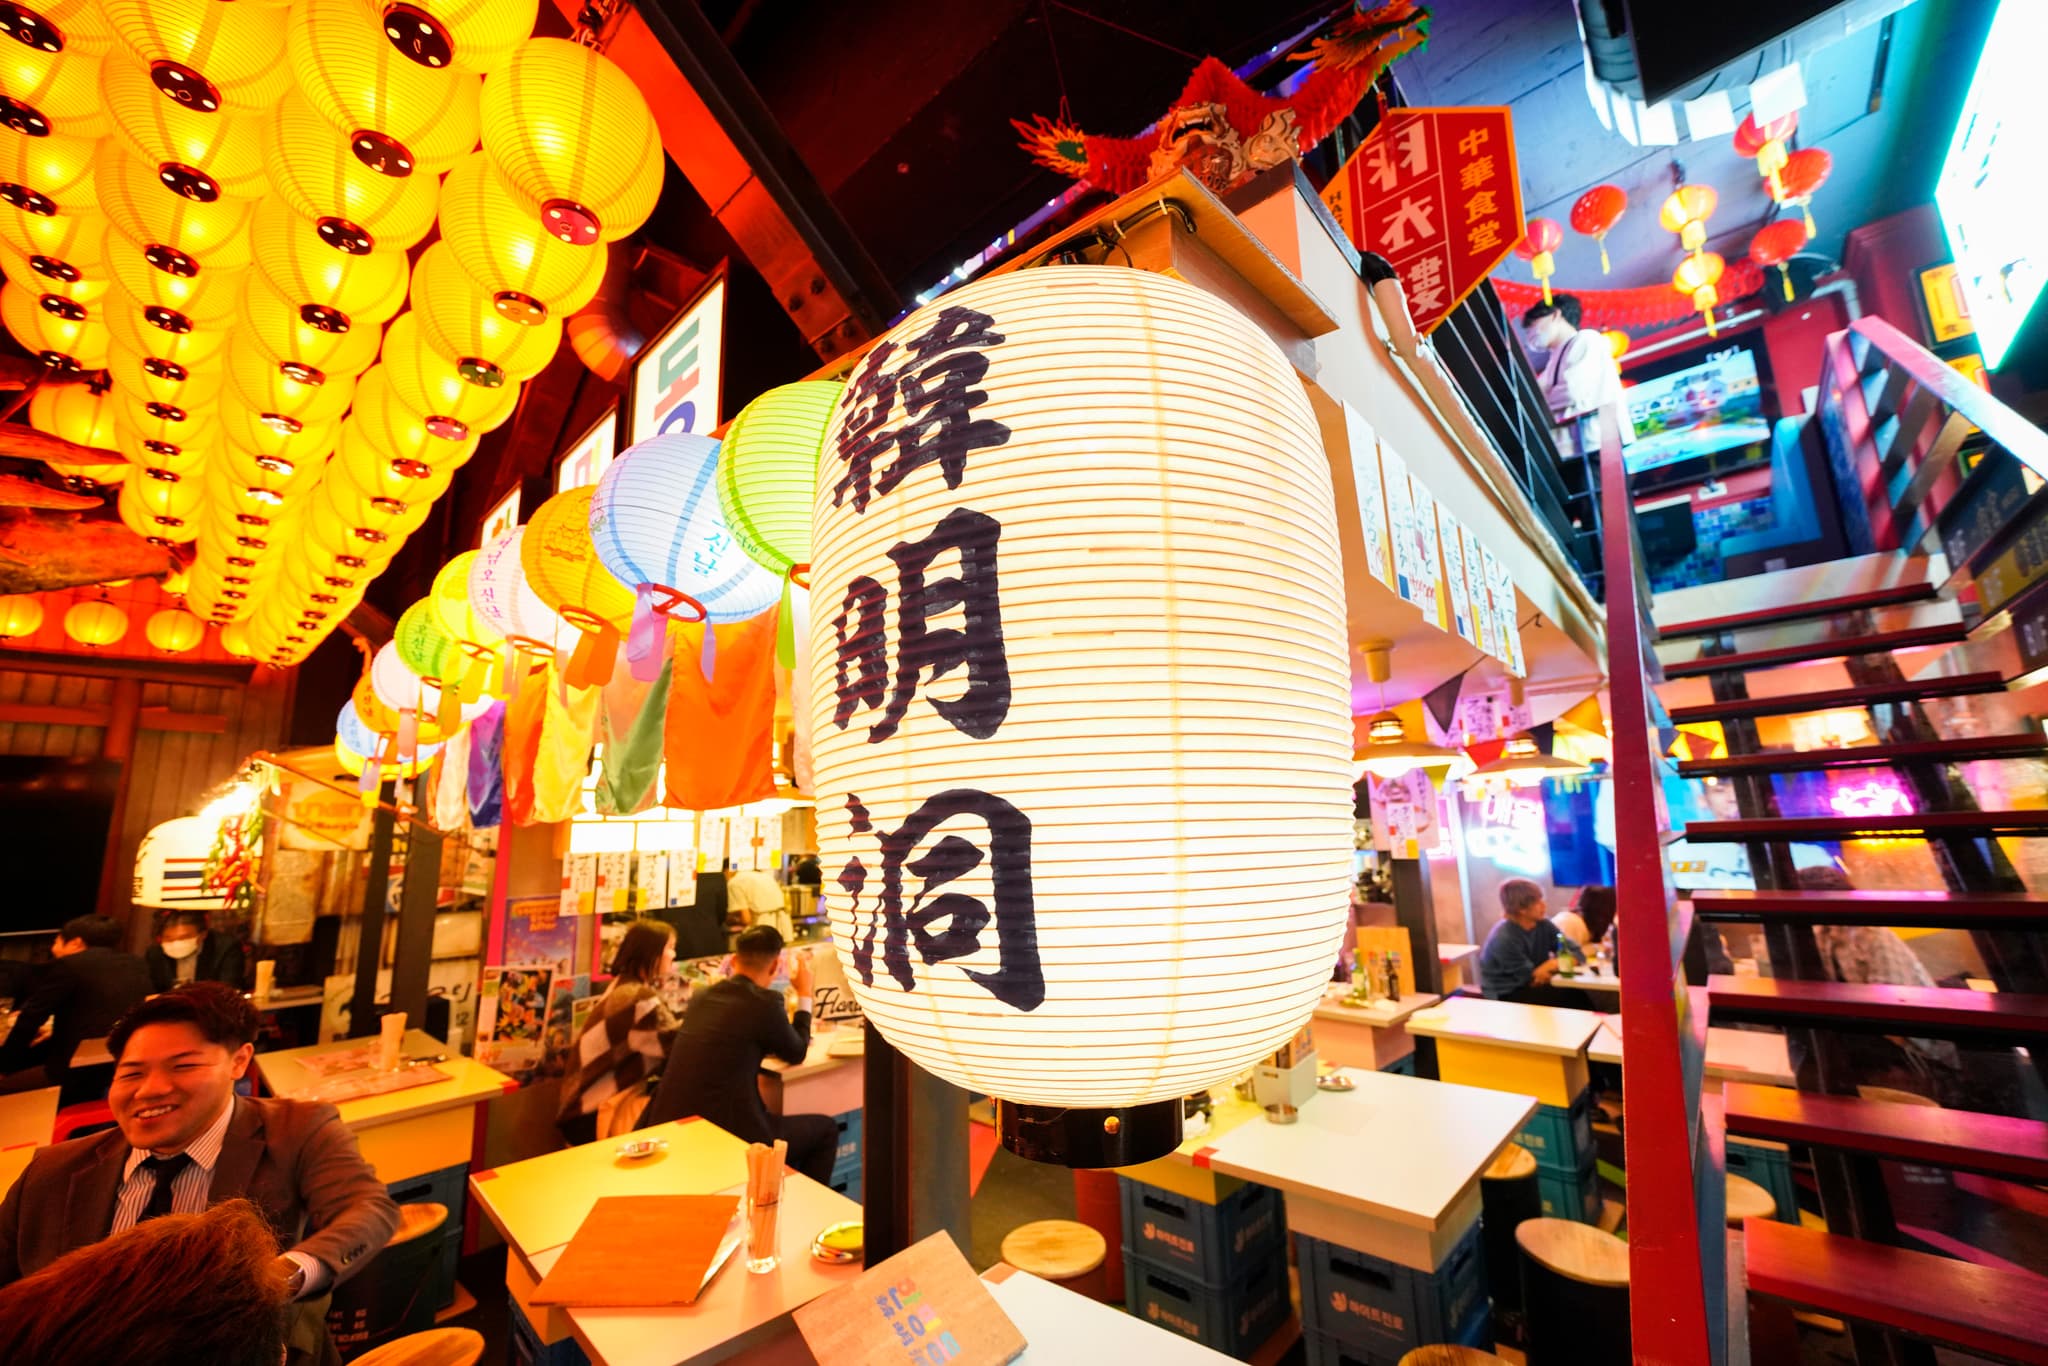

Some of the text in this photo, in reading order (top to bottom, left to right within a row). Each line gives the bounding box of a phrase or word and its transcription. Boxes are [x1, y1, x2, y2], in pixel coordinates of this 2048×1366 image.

[1458, 127, 1502, 256] 中華食堂
[831, 304, 1047, 1013] 韓明洞
